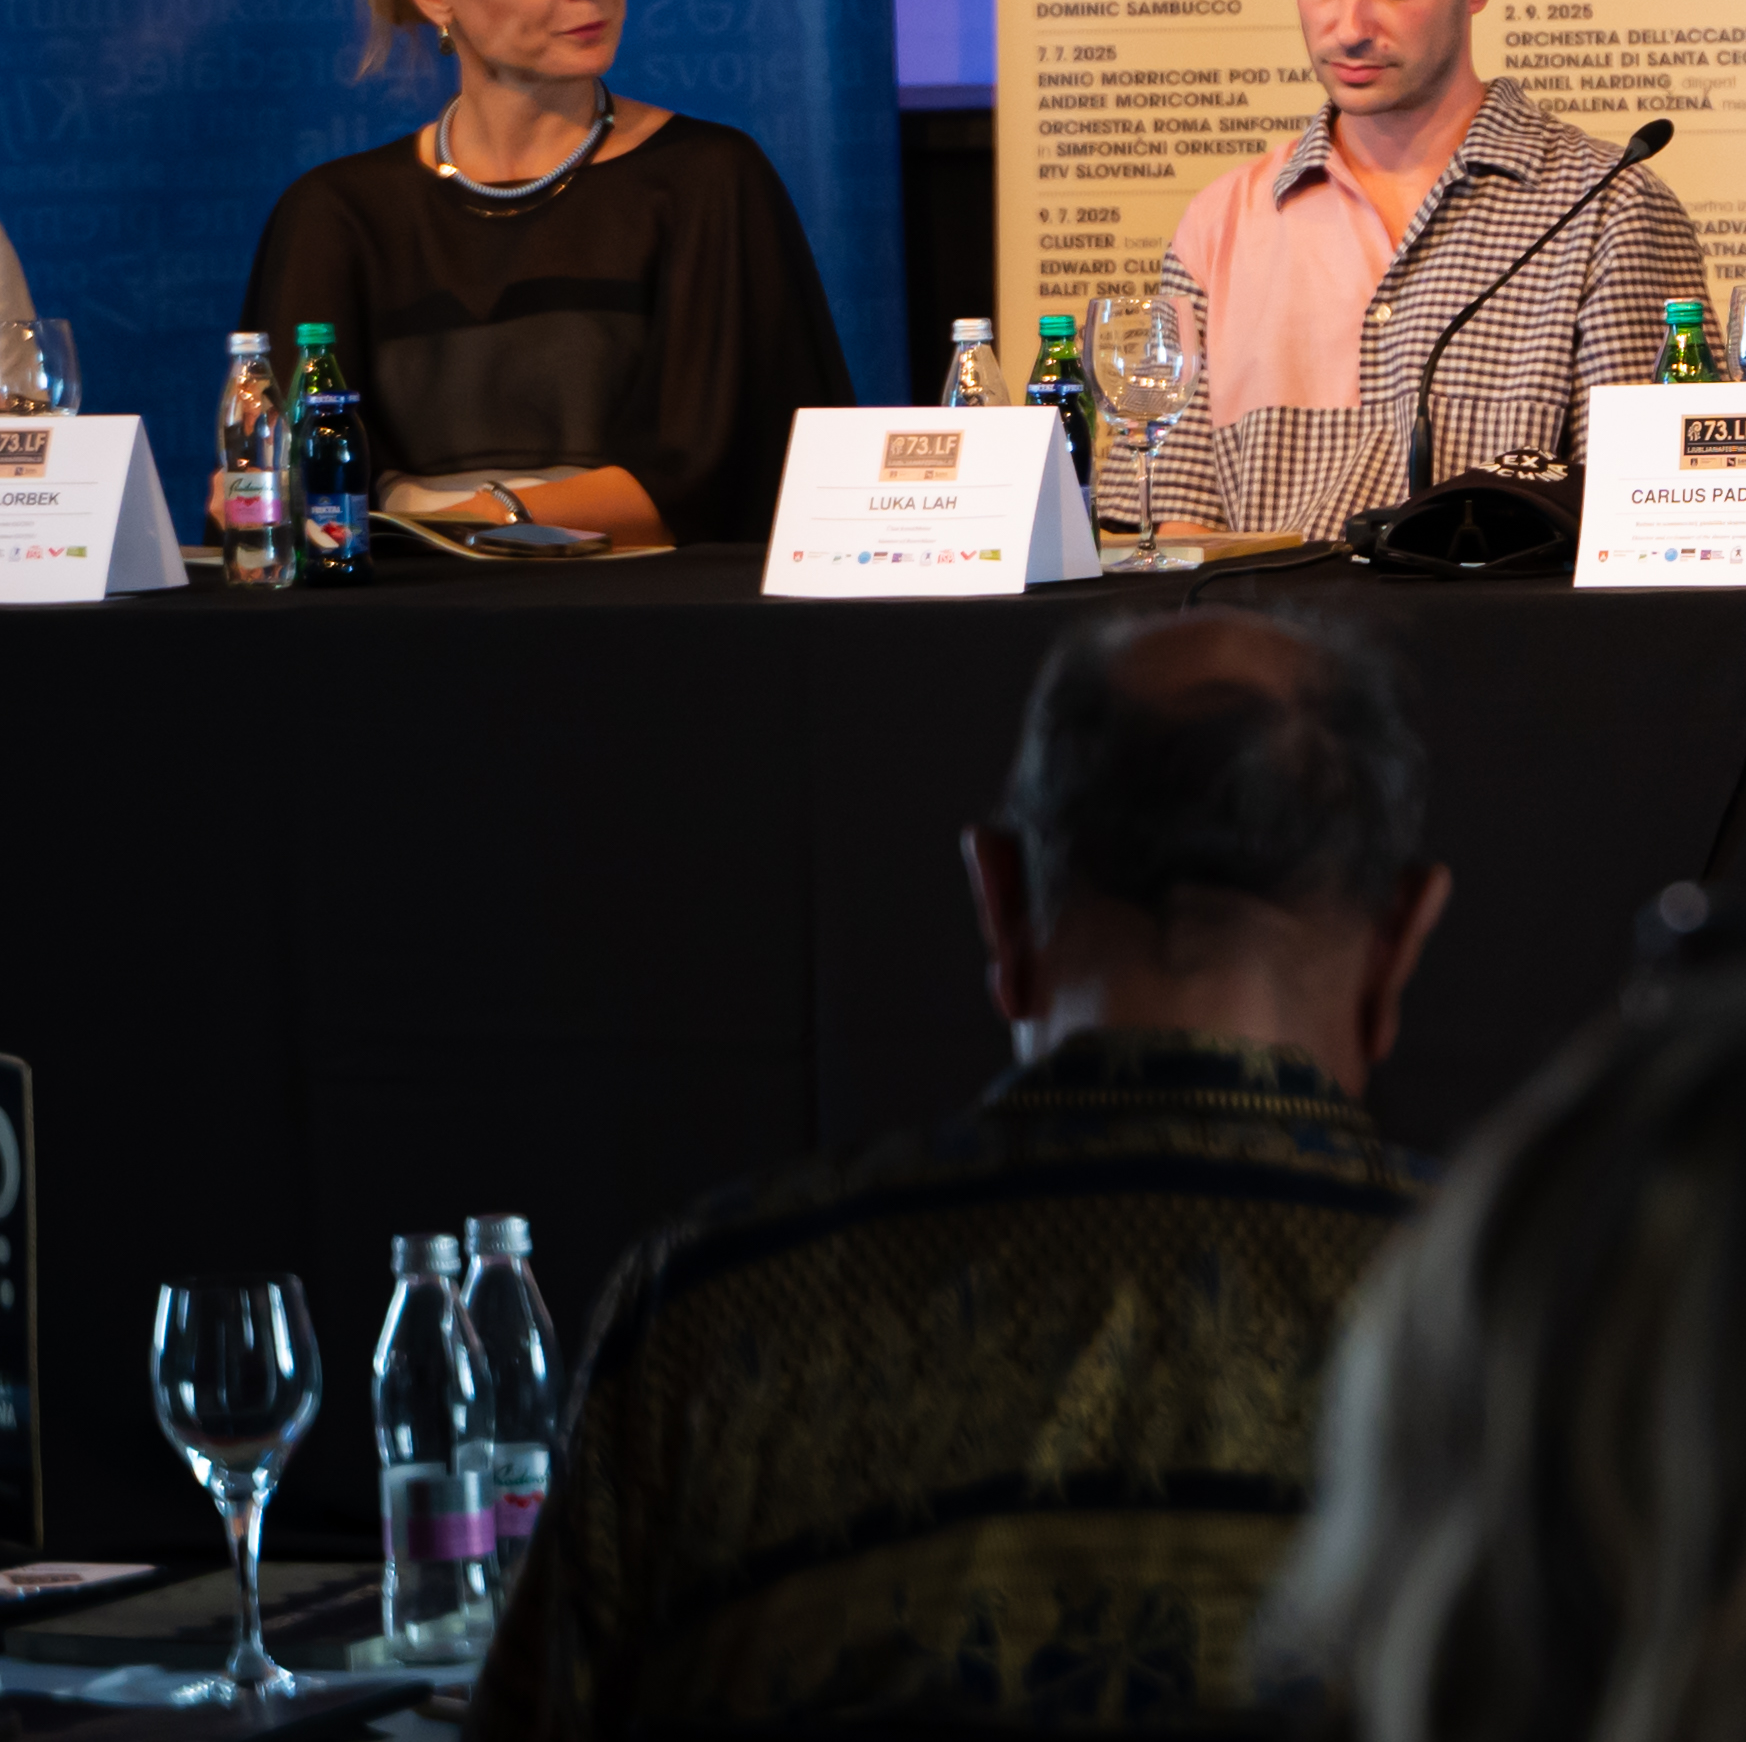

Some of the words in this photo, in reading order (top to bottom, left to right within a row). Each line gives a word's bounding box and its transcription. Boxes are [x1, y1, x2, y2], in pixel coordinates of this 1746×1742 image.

[1037, 1, 1119, 18] DOMINIC
[1506, 28, 1621, 47] ORCHESTRA
[1506, 51, 1613, 70] NAZIONALE
[1621, 51, 1641, 67] DI
[1648, 49, 1709, 67] SANTA
[1039, 119, 1147, 135] ORCHESTRA
[1153, 118, 1211, 134] ROMA
[869, 497, 916, 512] LUKA
[923, 495, 957, 510] LAH
[1631, 488, 1706, 504] CARLUS
